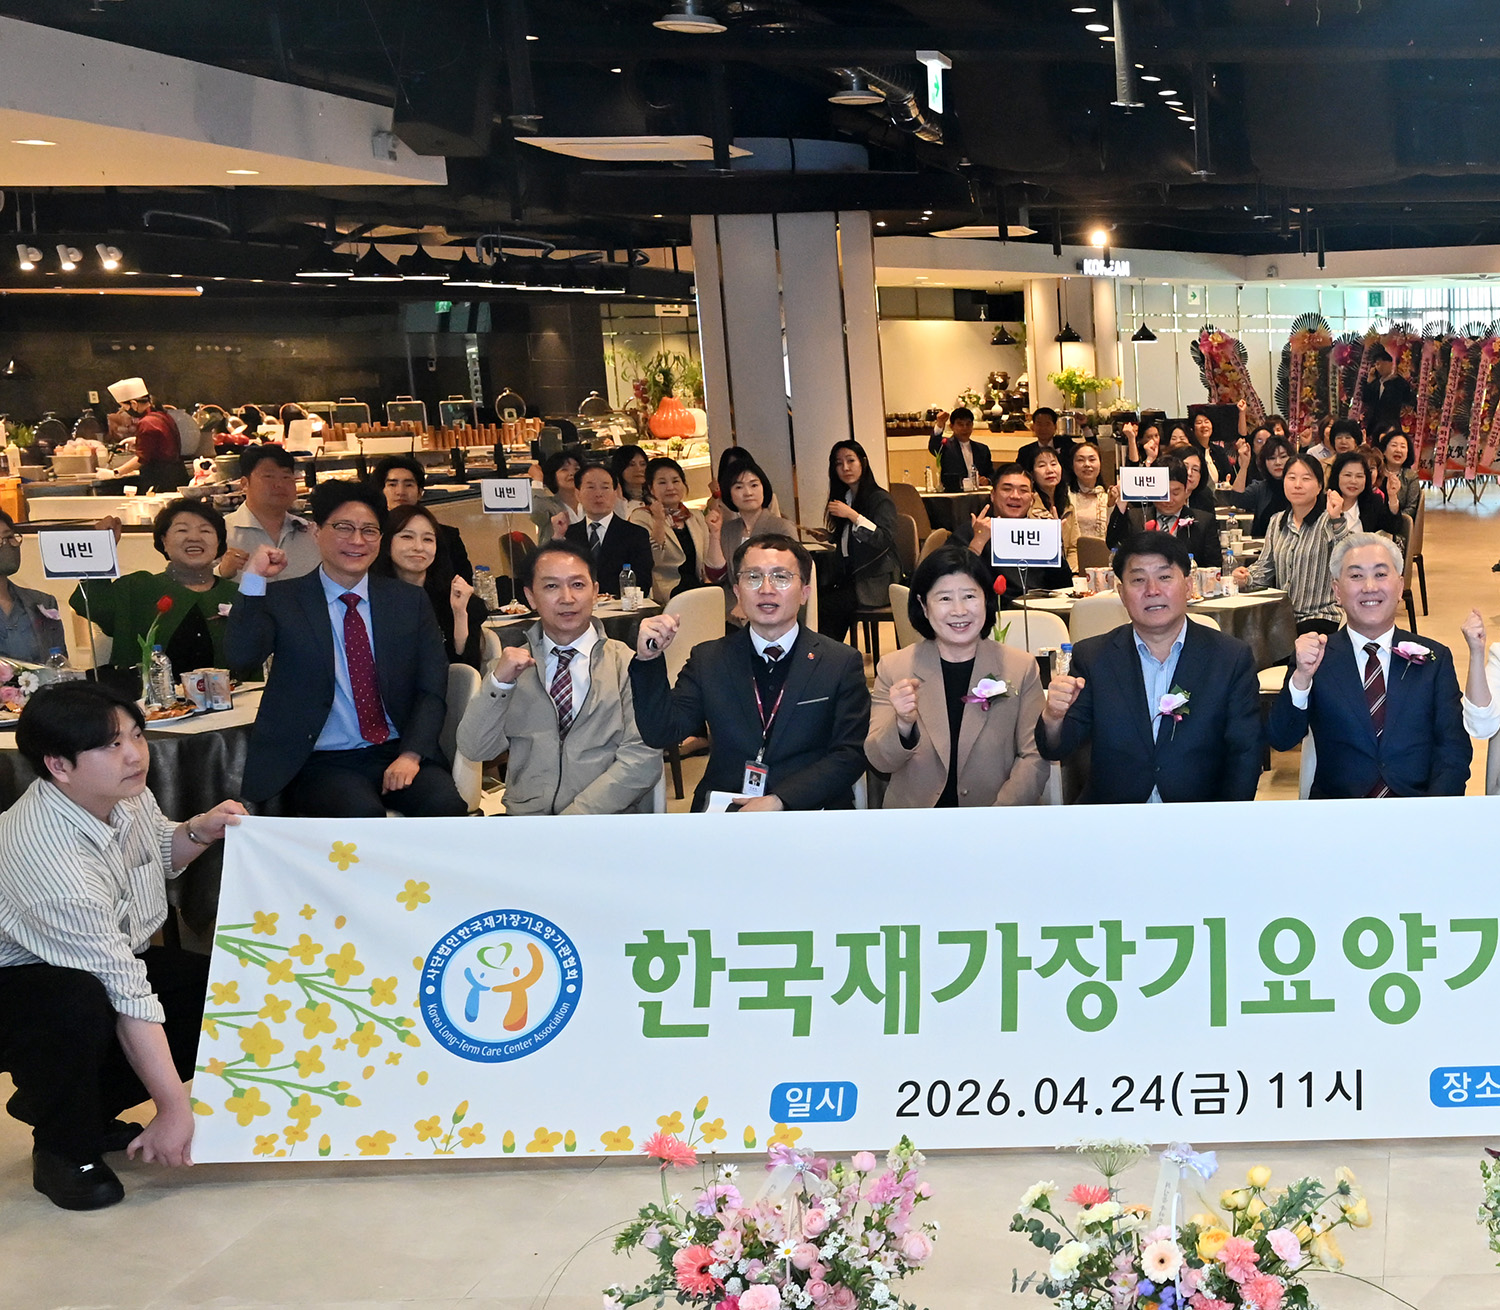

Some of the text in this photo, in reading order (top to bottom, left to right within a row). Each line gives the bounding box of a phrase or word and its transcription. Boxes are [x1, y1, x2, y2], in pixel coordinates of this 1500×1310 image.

[1134, 476, 1156, 488] 내빈
[494, 486, 516, 499] 내빈
[1010, 530, 1040, 546] 내빈
[59, 542, 93, 559] 내빈
[427, 1002, 571, 1056] Korea Long-Term Care Center Association
[785, 1069, 1362, 1119] 일시 2026.04.24(금) 11시
